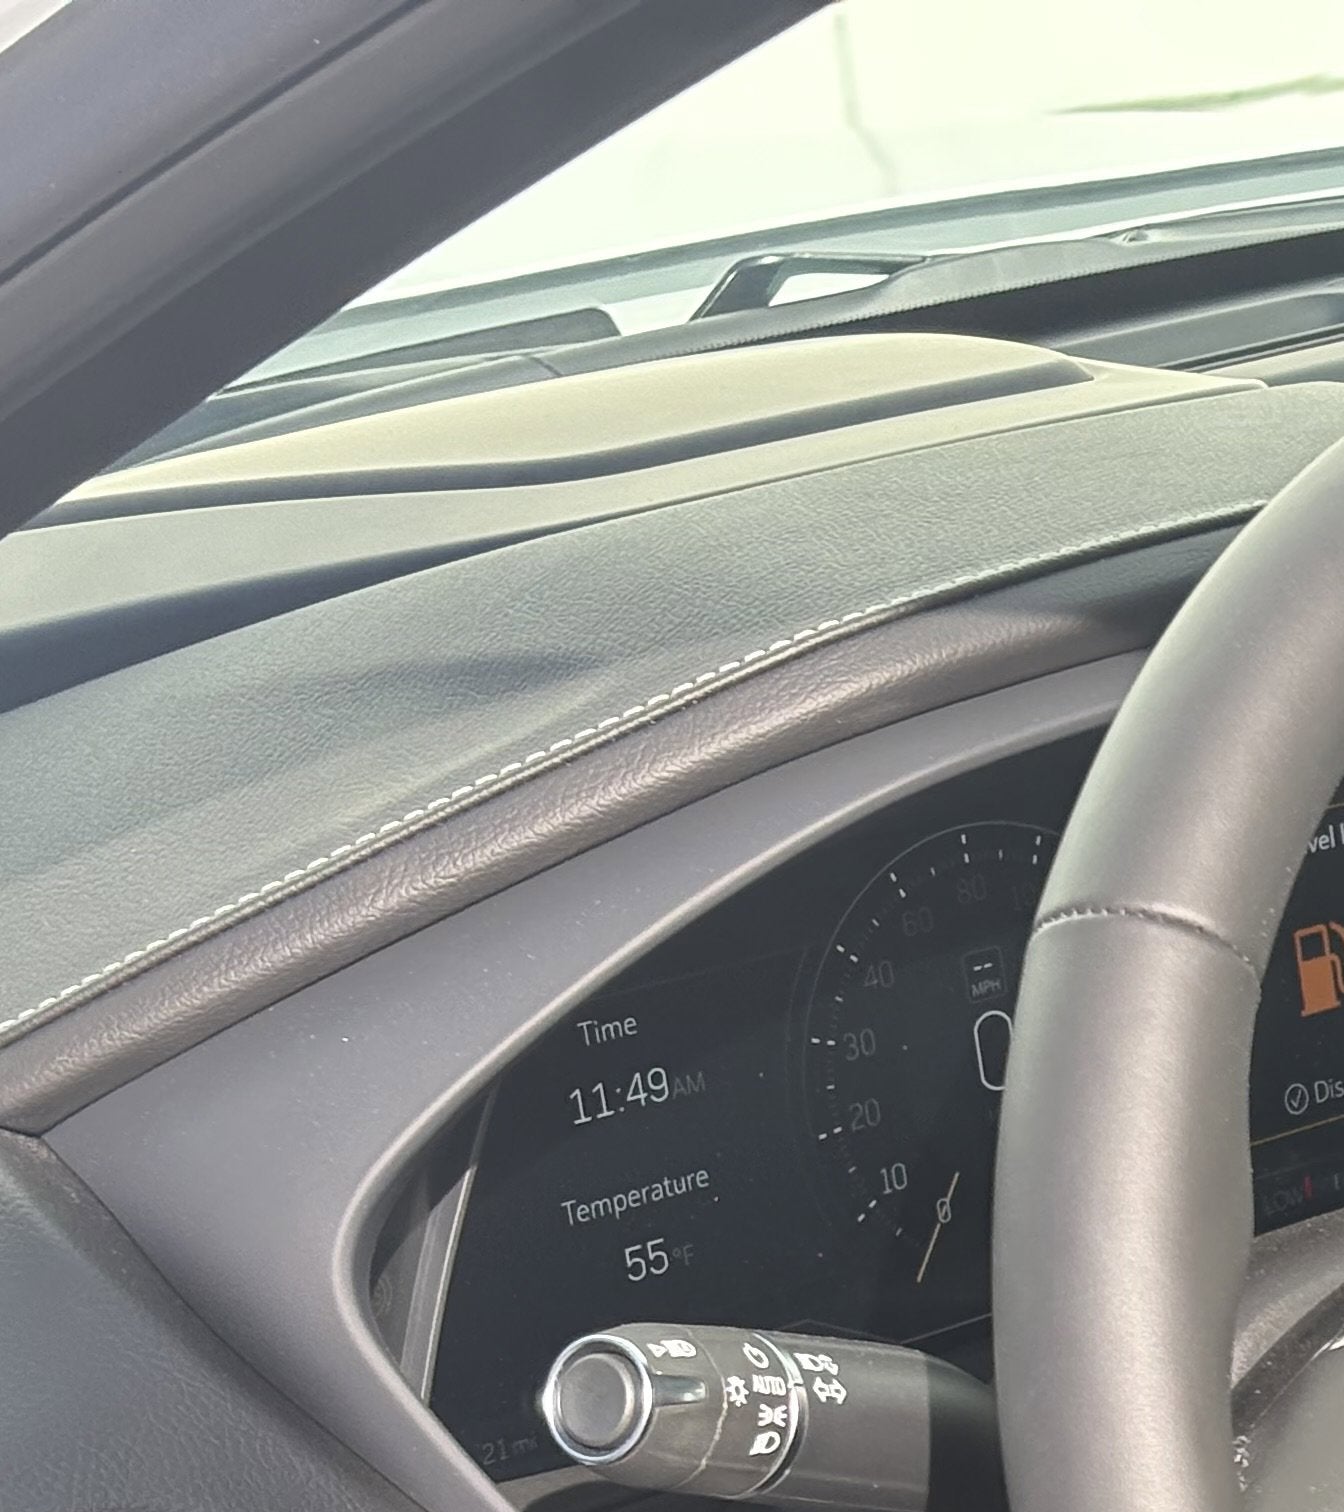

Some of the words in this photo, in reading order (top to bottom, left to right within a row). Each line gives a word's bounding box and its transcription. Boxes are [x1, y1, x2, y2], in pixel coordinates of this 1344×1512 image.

[1306, 825, 1336, 854] vel
[901, 905, 935, 937] 60
[862, 959, 896, 989] 40
[577, 1013, 639, 1049] Time
[841, 1028, 877, 1062] 30
[569, 1066, 670, 1126] 11:49
[847, 1096, 882, 1133] 20
[561, 1165, 711, 1227] Temperature
[878, 1161, 910, 1197] 10
[623, 1238, 671, 1283] 55
[752, 1374, 787, 1396] AUTO
